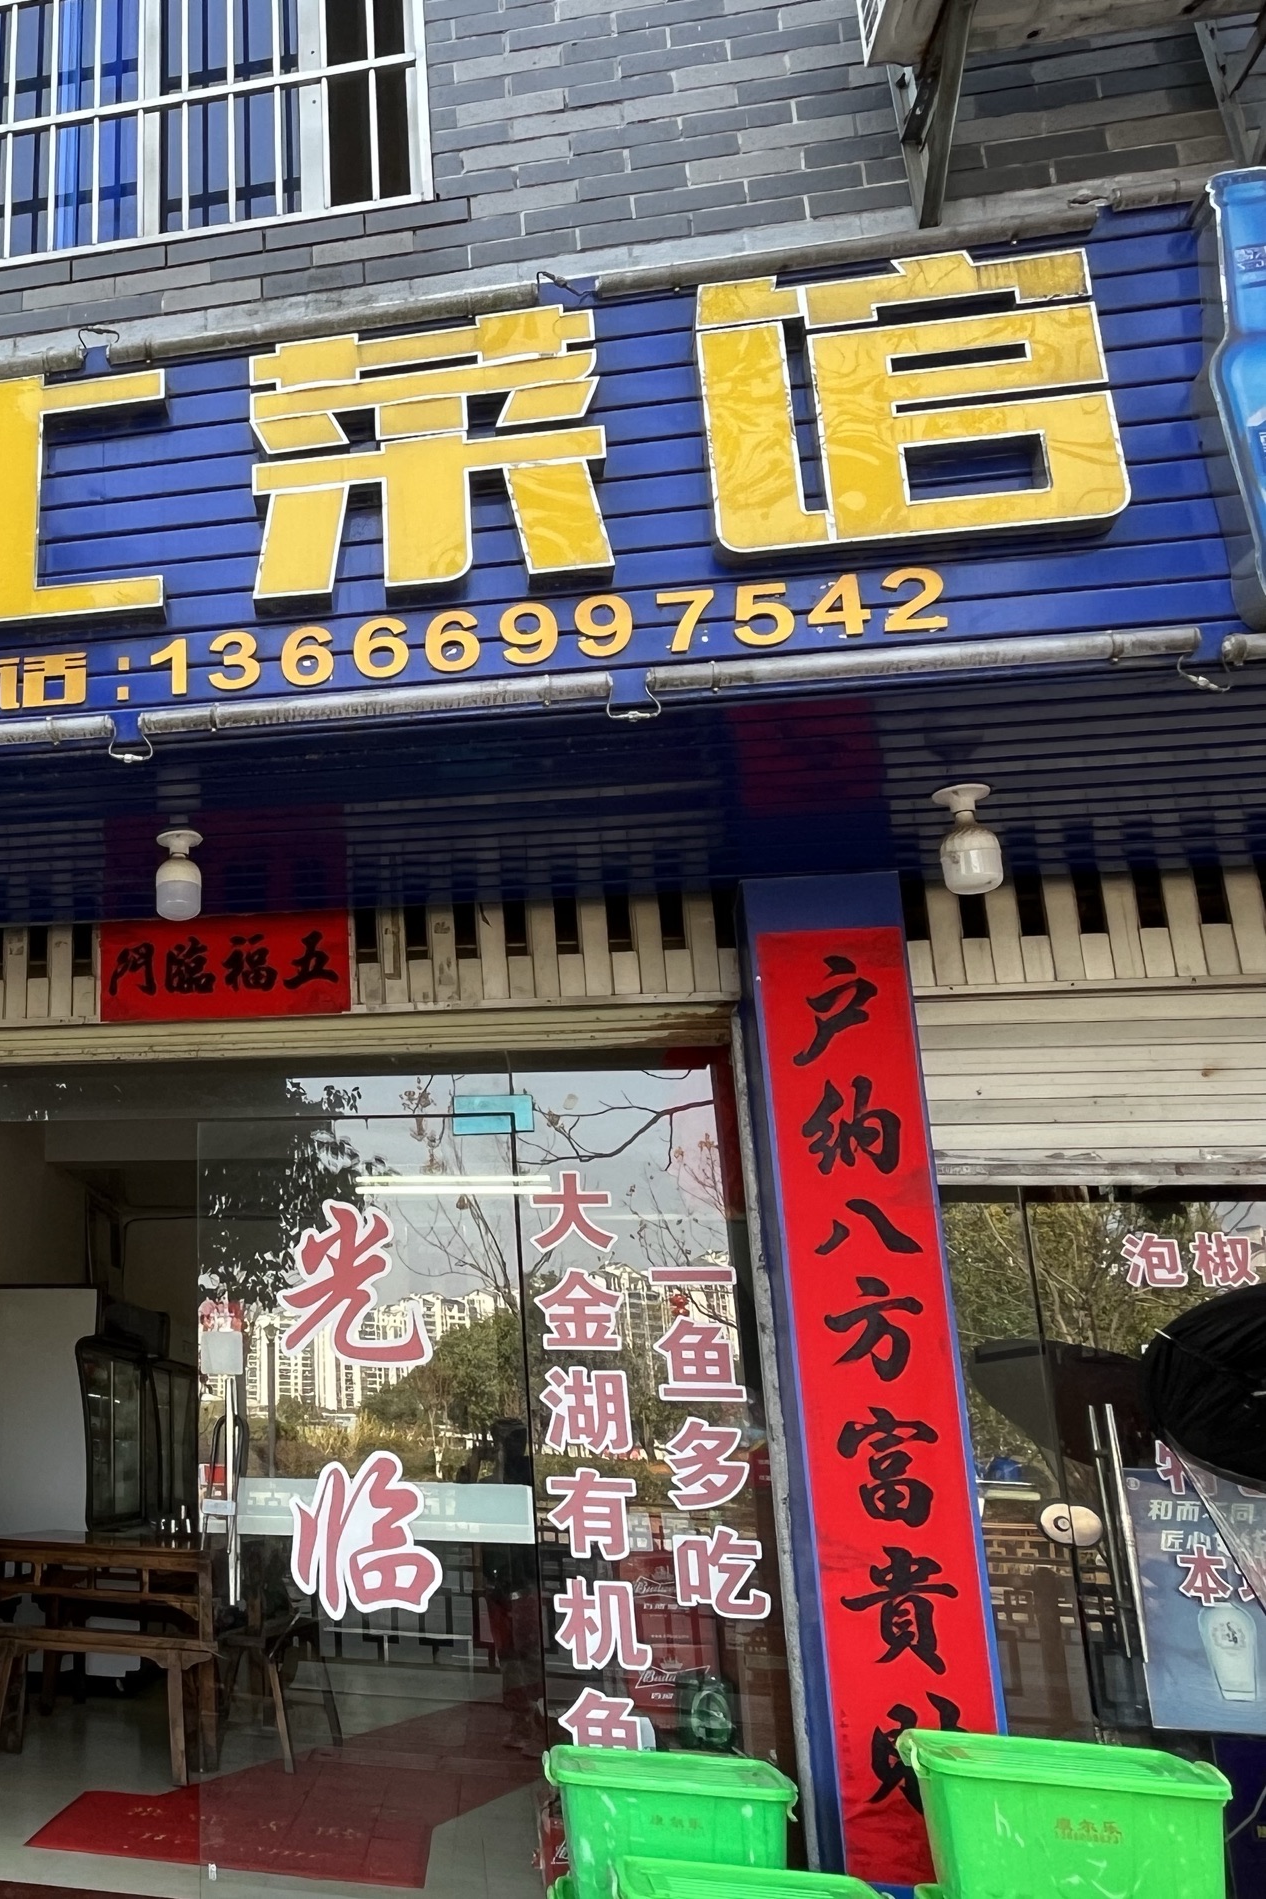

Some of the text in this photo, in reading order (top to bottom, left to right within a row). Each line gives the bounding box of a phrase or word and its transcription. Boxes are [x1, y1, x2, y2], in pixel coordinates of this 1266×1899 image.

[277, 1200, 443, 1620] 光临
[1120, 1231, 1260, 1288] 泡椒
[529, 1170, 653, 1750] 大金湖有机鱼
[648, 1265, 771, 1619] 一鱼多吃
[1147, 1499, 1257, 1526] 和而同
